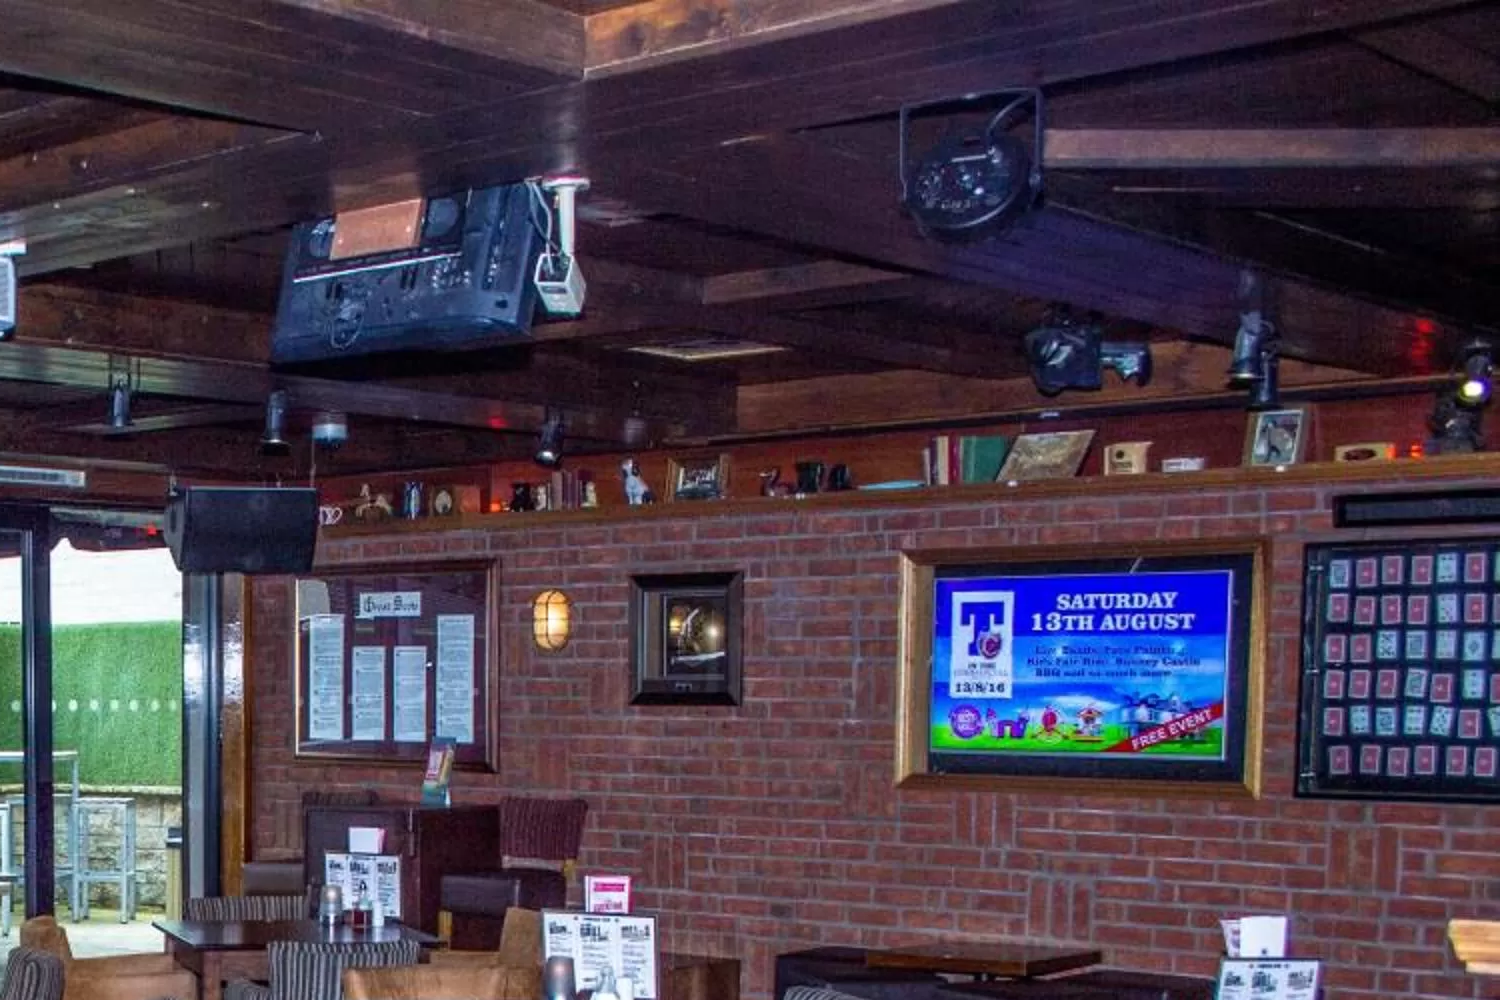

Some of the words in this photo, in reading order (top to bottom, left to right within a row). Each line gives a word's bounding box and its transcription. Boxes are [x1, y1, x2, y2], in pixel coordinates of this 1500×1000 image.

[1056, 592, 1178, 610] SATURDAY
[960, 602, 1004, 656] T
[1031, 612, 1094, 631] 13TH
[1100, 613, 1196, 631] AUGUST
[1131, 727, 1169, 751] FREE
[1168, 708, 1212, 736] EVENT
